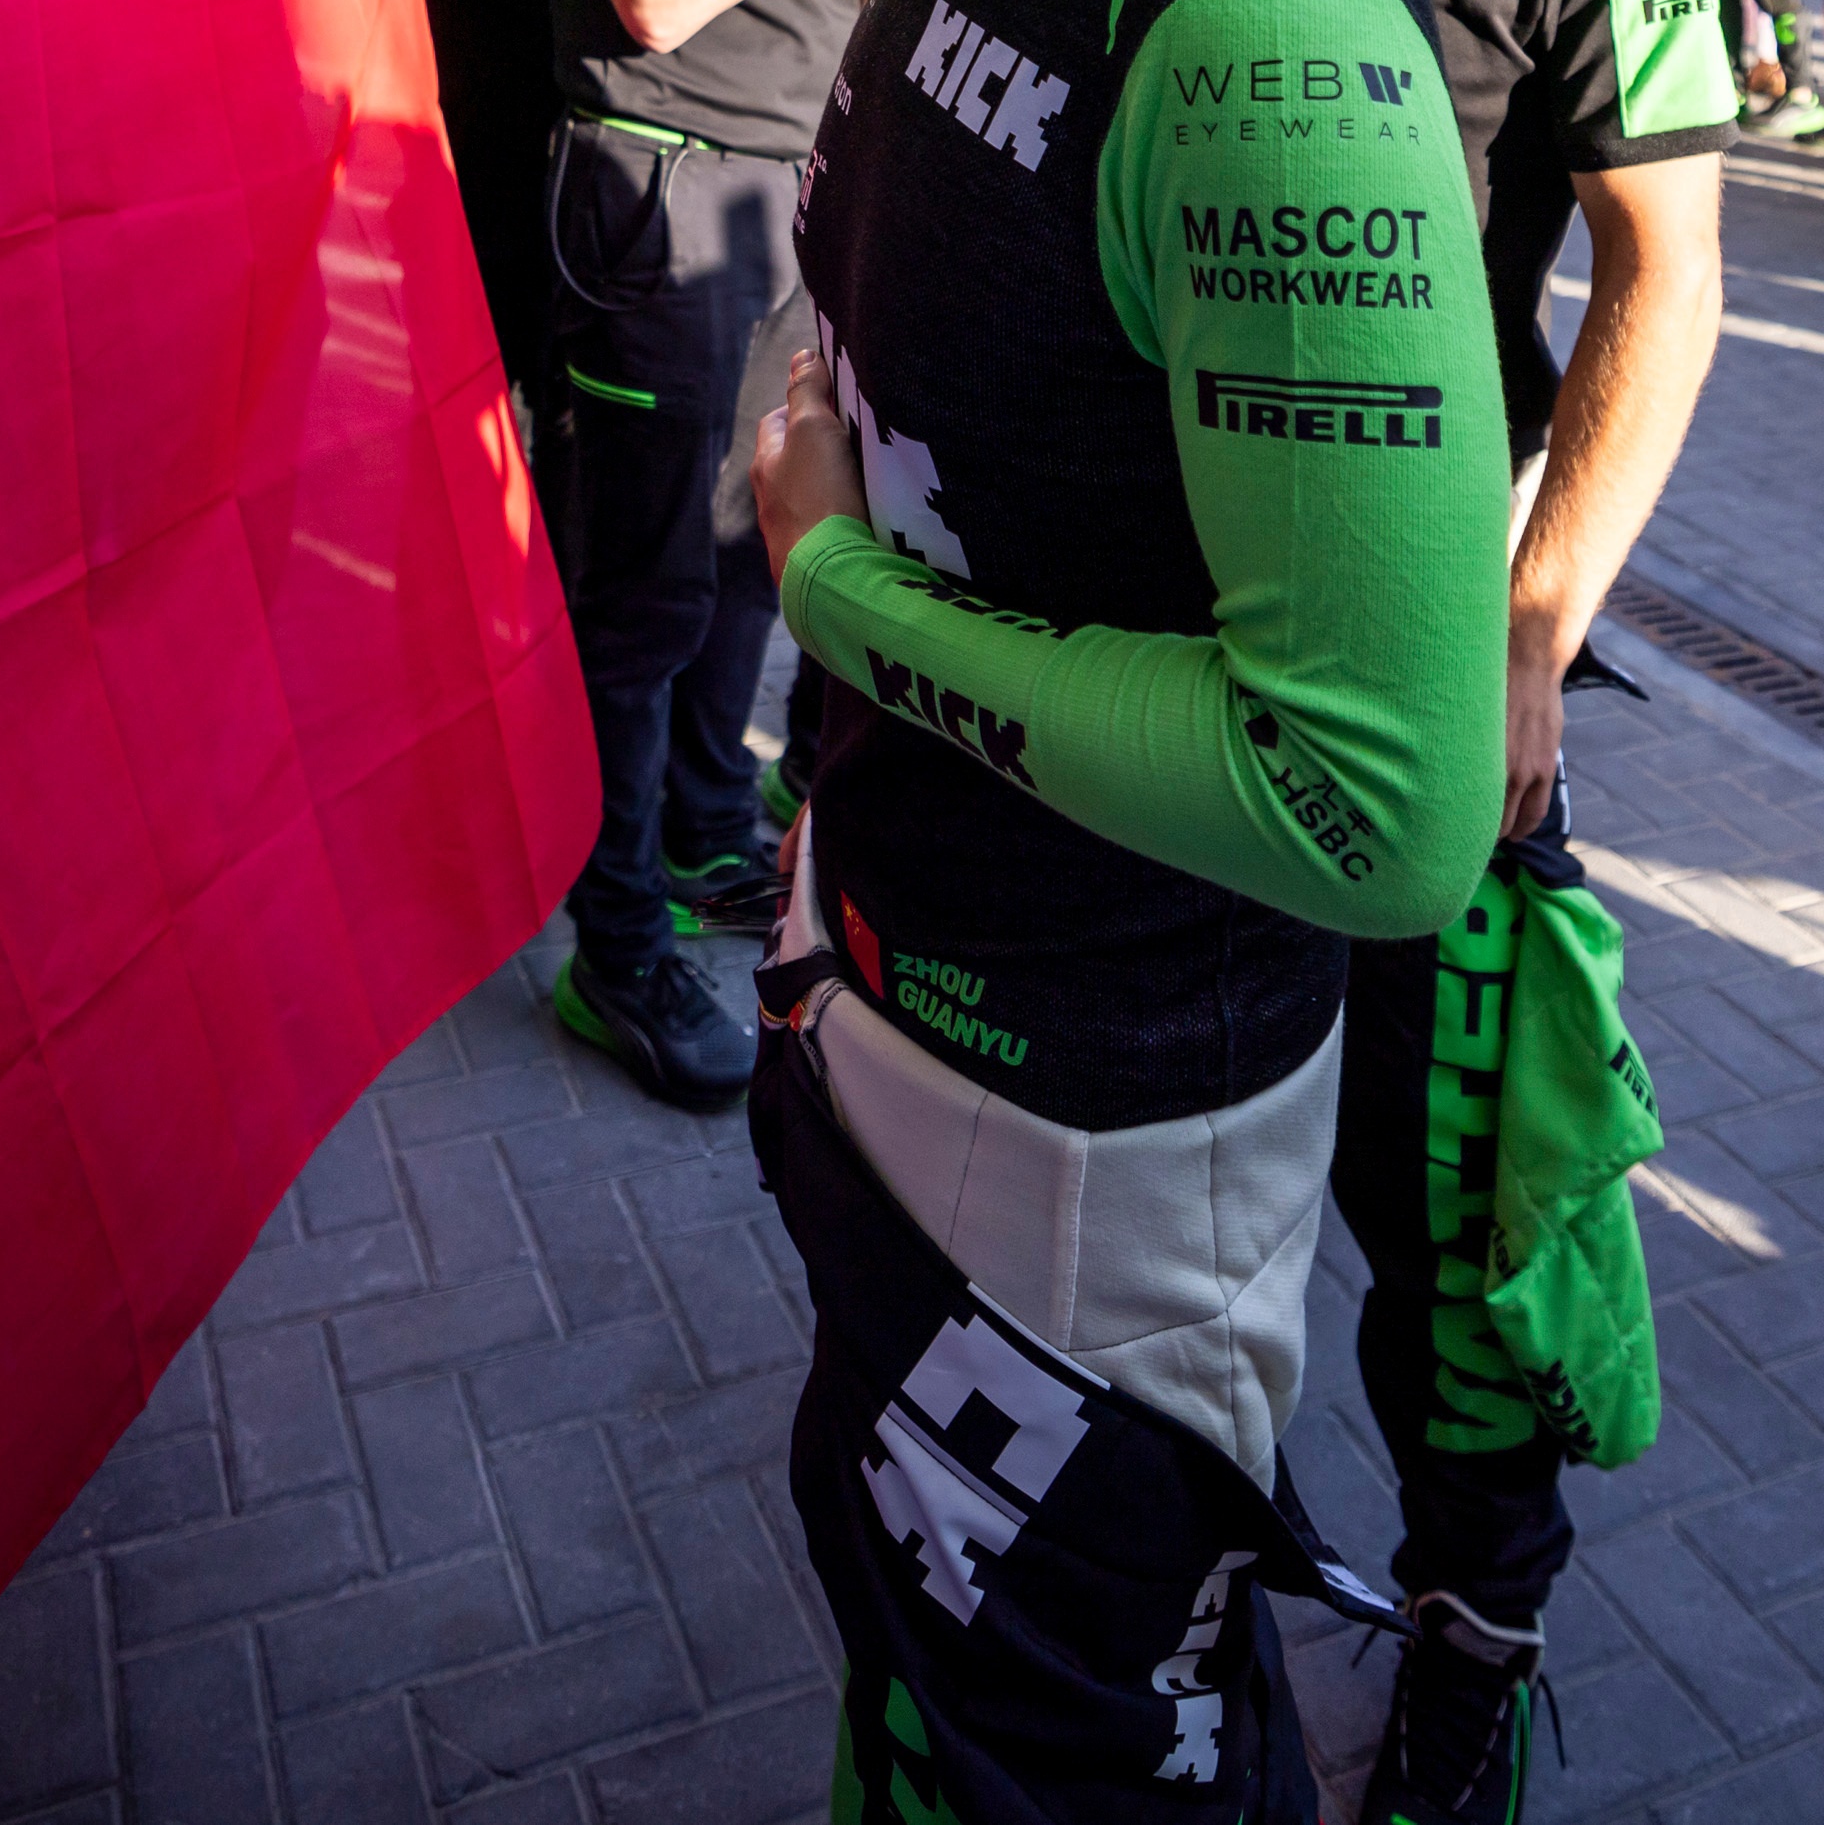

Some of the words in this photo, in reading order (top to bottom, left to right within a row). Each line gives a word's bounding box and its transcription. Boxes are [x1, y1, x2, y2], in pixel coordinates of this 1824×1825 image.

[1173, 59, 1344, 106] WEB
[1175, 118, 1421, 146] EYEWEAR
[1181, 205, 1427, 261] MASCOT
[1189, 263, 1434, 310] WORKWEAR
[1195, 368, 1444, 449] PIRELLI
[865, 645, 1039, 793] KICK
[1271, 766, 1375, 882] HSBC
[893, 951, 986, 1006] ZHOU
[897, 979, 1029, 1067] GUANYU
